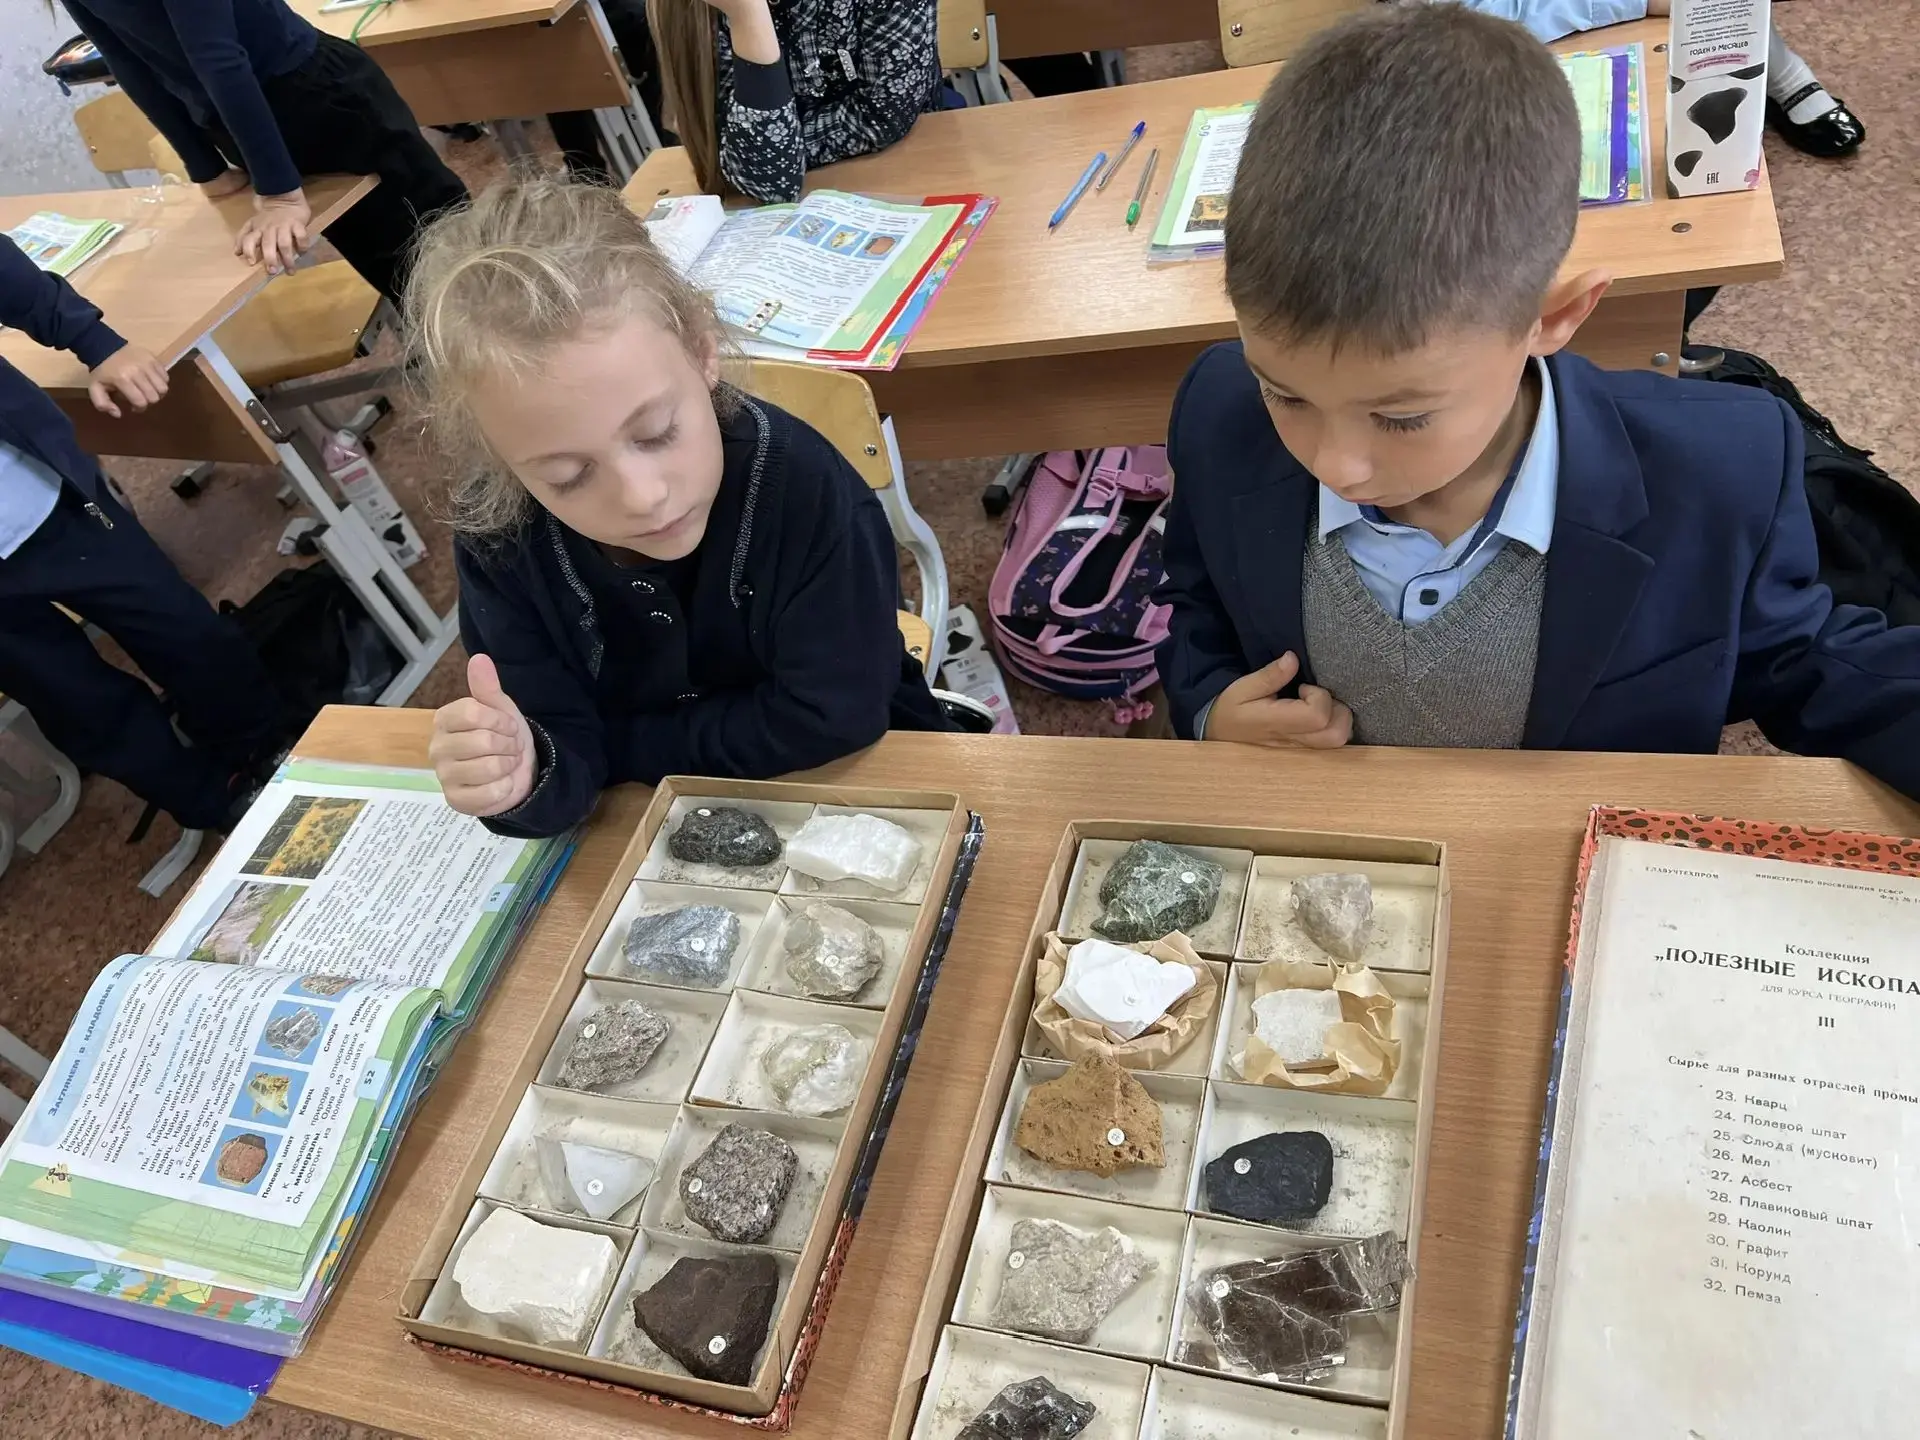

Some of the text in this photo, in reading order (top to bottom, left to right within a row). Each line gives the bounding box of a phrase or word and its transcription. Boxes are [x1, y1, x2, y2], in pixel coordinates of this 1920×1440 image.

[1690, 46, 1710, 56] ГОДЕН
[1718, 41, 1748, 51] МЕСЯЦЕВ
[1784, 943, 1871, 965] Коллекция
[184, 993, 202, 1024] работа
[1761, 984, 1896, 1010] ДЛЯ КУРСА ГЕОГРАФИИ
[364, 1002, 382, 1033] кварца
[323, 1023, 338, 1052] Слюда
[350, 1041, 366, 1071] шпата,
[56, 1117, 81, 1151] Узнаем,
[81, 1093, 92, 1108] что
[92, 1060, 106, 1084] такое
[106, 1021, 122, 1053] горные
[122, 983, 142, 1014] породы
[72, 969, 166, 1154] Обсудим поучительную историю одной
[145, 1089, 173, 1139] Рассмотри
[172, 1049, 190, 1083] кусочек
[188, 1007, 207, 1042] гранита
[150, 1118, 169, 1147] Найди
[168, 1073, 188, 1111] цветные
[200, 1013, 212, 1030] Это
[172, 1109, 190, 1138] Найди
[200, 1016, 228, 1065] блестящие
[184, 1098, 211, 1148] Рассмотри
[210, 1052, 230, 1091] образцы
[228, 1005, 249, 1046] полевого
[364, 1070, 376, 1084] 52
[1668, 1055, 1710, 1070] Сырье
[1716, 1064, 1740, 1074] для
[1747, 1068, 1796, 1083] разных
[1803, 1076, 1866, 1095] отраслей
[64, 1109, 92, 1152] Научимся
[94, 1054, 117, 1099] различать
[100, 1140, 109, 1149] С
[109, 1101, 128, 1134] какими
[128, 1054, 148, 1094] камнями
[147, 1034, 156, 1047] мы
[103, 1135, 119, 1162] шлом
[119, 1093, 140, 1130] учебном
[138, 1062, 152, 1087] году?
[150, 1042, 161, 1057] Как
[160, 1021, 169, 1036] мы
[162, 1110, 180, 1140] Найди
[174, 1030, 218, 1104] полупрозрачные
[289, 1133, 311, 1175] неживой
[310, 1086, 330, 1126] природе
[329, 1033, 354, 1079] относятся
[349, 995, 370, 1026] горные
[293, 1132, 320, 1186] минералы.
[320, 1095, 336, 1120] Одна
[335, 1074, 344, 1085] из
[343, 1032, 359, 1065] горных
[359, 996, 378, 1023] пород
[298, 1088, 315, 1115] Кварц
[326, 1077, 351, 1120] полевого
[1715, 1090, 1788, 1112] 23. Кварц
[186, 1159, 200, 1180] зуют
[200, 1120, 219, 1153] горную
[217, 1081, 236, 1115] породу
[201, 1110, 215, 1128] Эти
[322, 1127, 332, 1139] из
[1714, 1110, 1847, 1140] 24. Полевой шпат
[111, 1125, 132, 1163] камней?
[163, 1122, 192, 1176] рал слюда.
[1712, 1149, 1771, 1168] 26. Мел
[1713, 1130, 1878, 1169] 25. Слюда (мусковит)
[261, 1135, 294, 1199] Полевой шпат
[304, 1146, 323, 1184] состоит
[1711, 1170, 1793, 1193] 27. Асбест
[292, 1190, 304, 1204] Он
[1709, 1190, 1874, 1230] 28. Плавиковый шпат
[1708, 1211, 1792, 1237] 29. Каолин
[1706, 1233, 1789, 1258] 30. Графит
[1710, 1256, 1792, 1284] 31. Корунд
[1704, 1278, 1782, 1304] 32. Пемза
